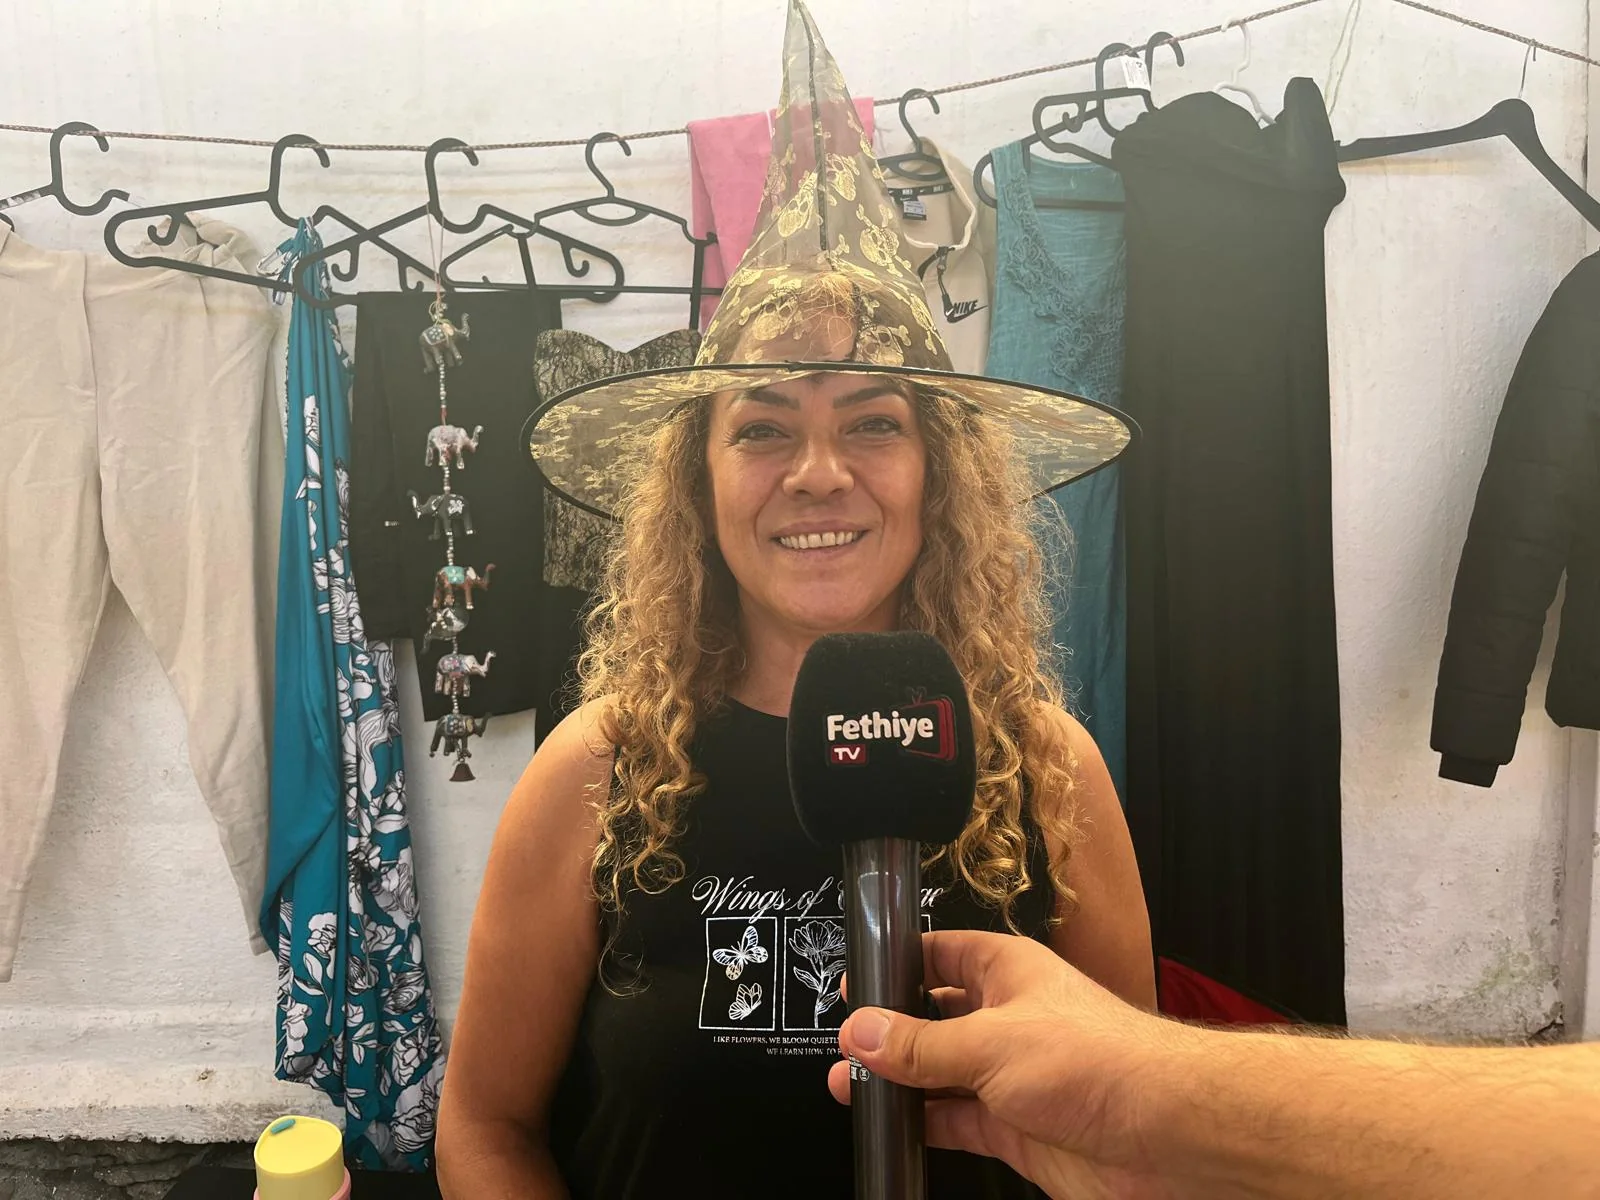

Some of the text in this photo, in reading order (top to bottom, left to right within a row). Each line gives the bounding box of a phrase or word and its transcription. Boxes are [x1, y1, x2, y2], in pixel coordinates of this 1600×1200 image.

[827, 711, 934, 746] Fethiye
[834, 747, 861, 760] TV
[692, 875, 790, 923] Wings
[785, 876, 834, 921] of
[713, 1035, 730, 1043] LIKE
[768, 1036, 781, 1044] WE
[782, 1036, 809, 1044] BLOOM
[766, 1047, 779, 1055] WE
[780, 1047, 804, 1055] LEARN
[826, 1047, 837, 1055] TO
